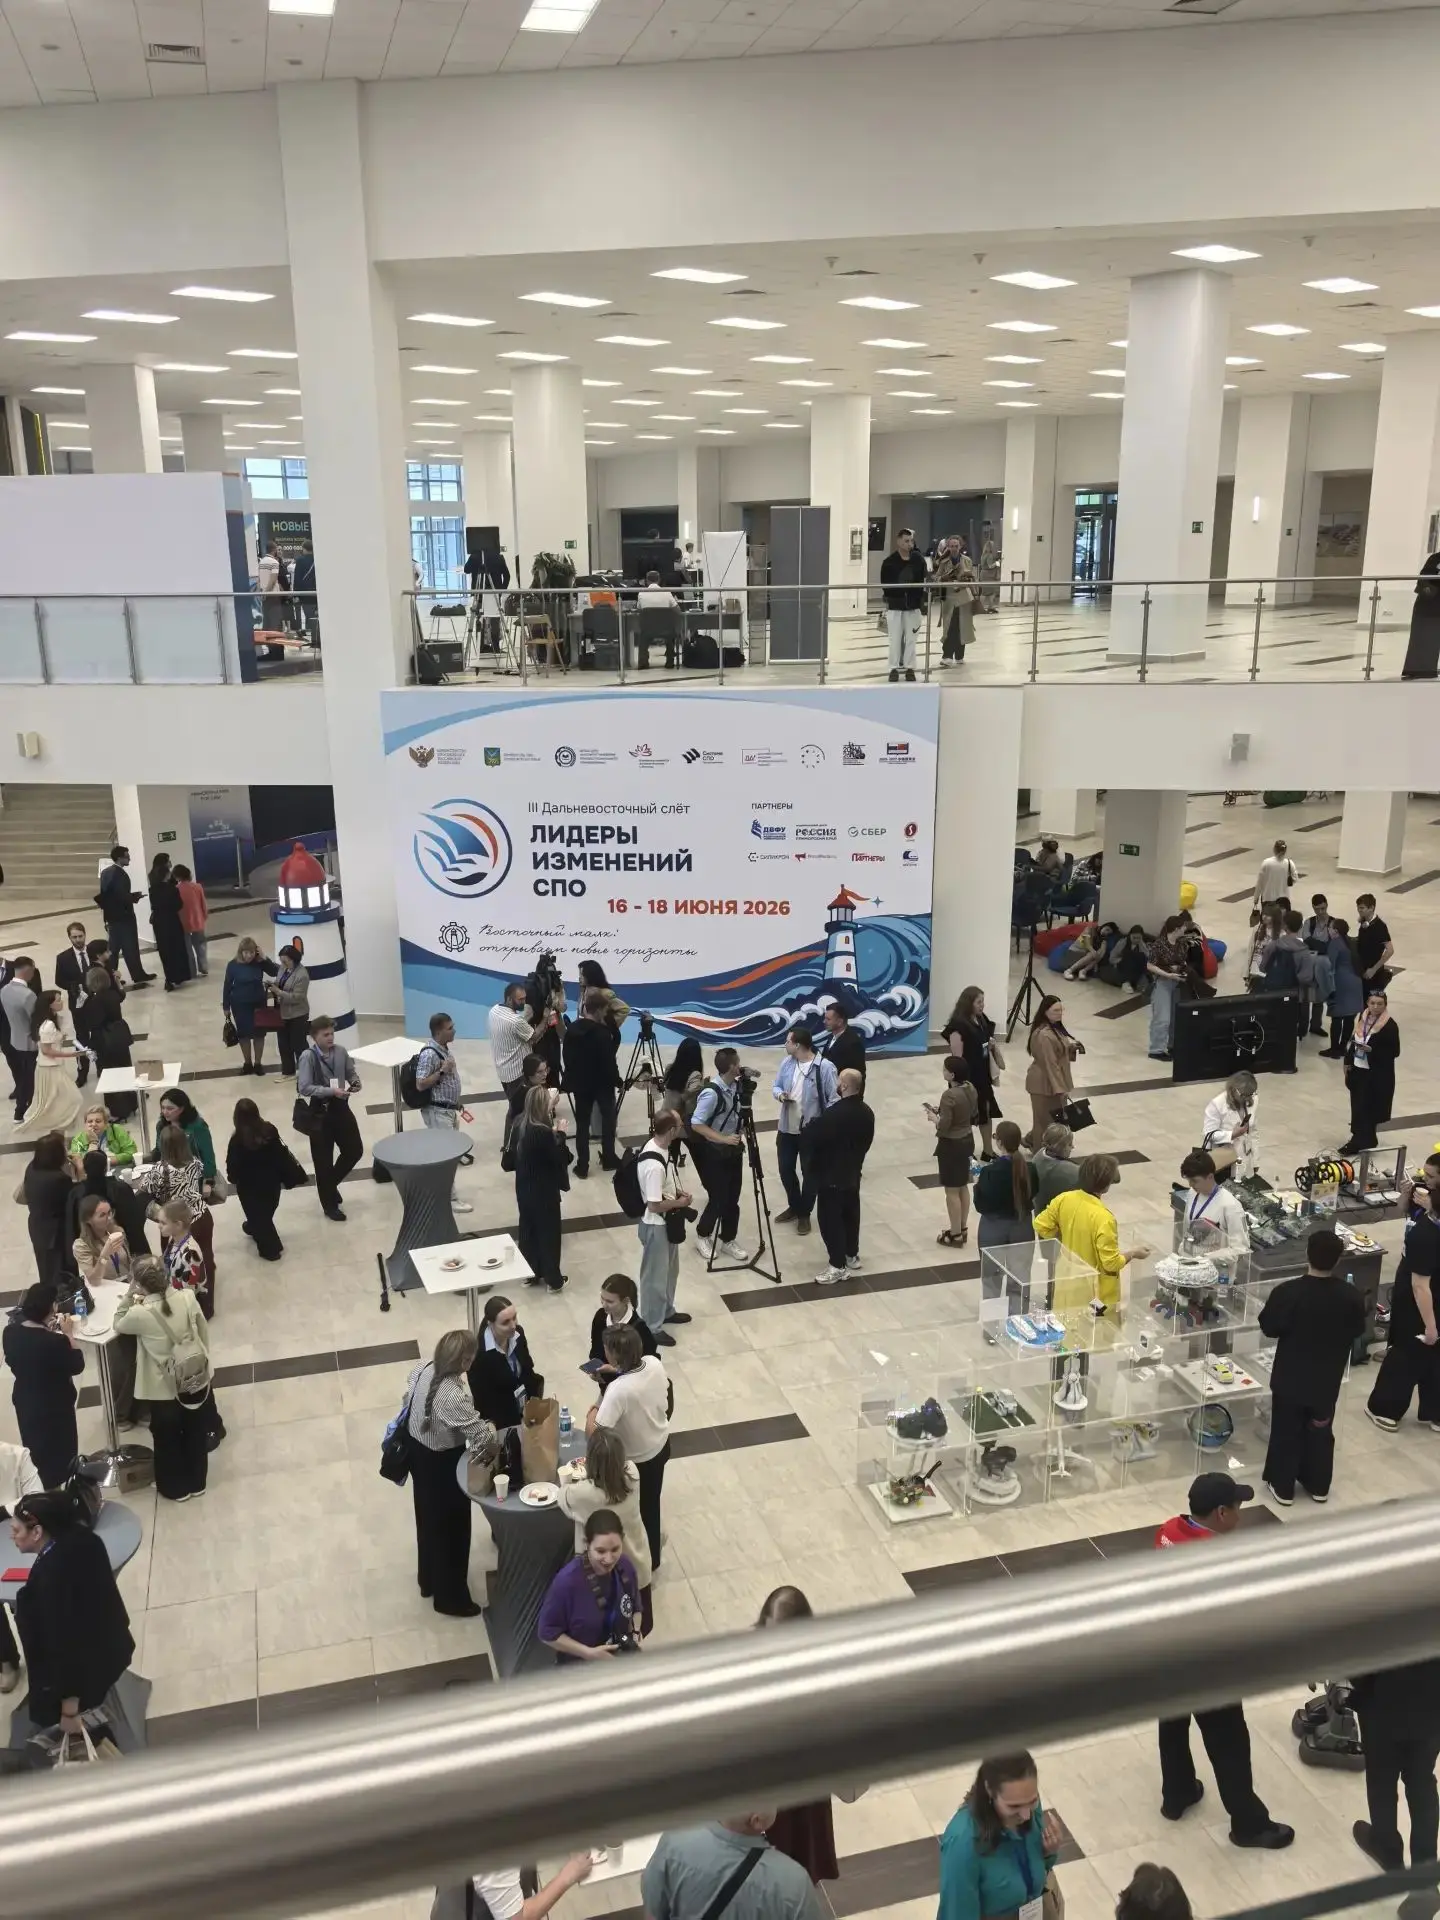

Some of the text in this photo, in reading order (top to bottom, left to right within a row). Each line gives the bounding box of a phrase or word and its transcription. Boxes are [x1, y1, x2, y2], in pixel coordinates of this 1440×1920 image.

[272, 521, 309, 532] НОВЫЕ
[542, 802, 657, 815] Дальневосточный
[660, 803, 690, 814] слёт
[530, 825, 638, 847] ЛИДЕРЫ
[796, 828, 837, 836] РОССИЯ
[861, 828, 887, 836] СБЕР
[532, 848, 693, 872] ИЗМЕНЕНИЙ
[533, 879, 587, 897] СПО
[608, 899, 628, 914] 16
[648, 900, 668, 914] 18
[674, 900, 738, 915] ИЮНЯ
[743, 900, 791, 915] 2026
[479, 923, 566, 937] Восточный
[570, 941, 609, 954] новые
[613, 947, 698, 964] горизонты
